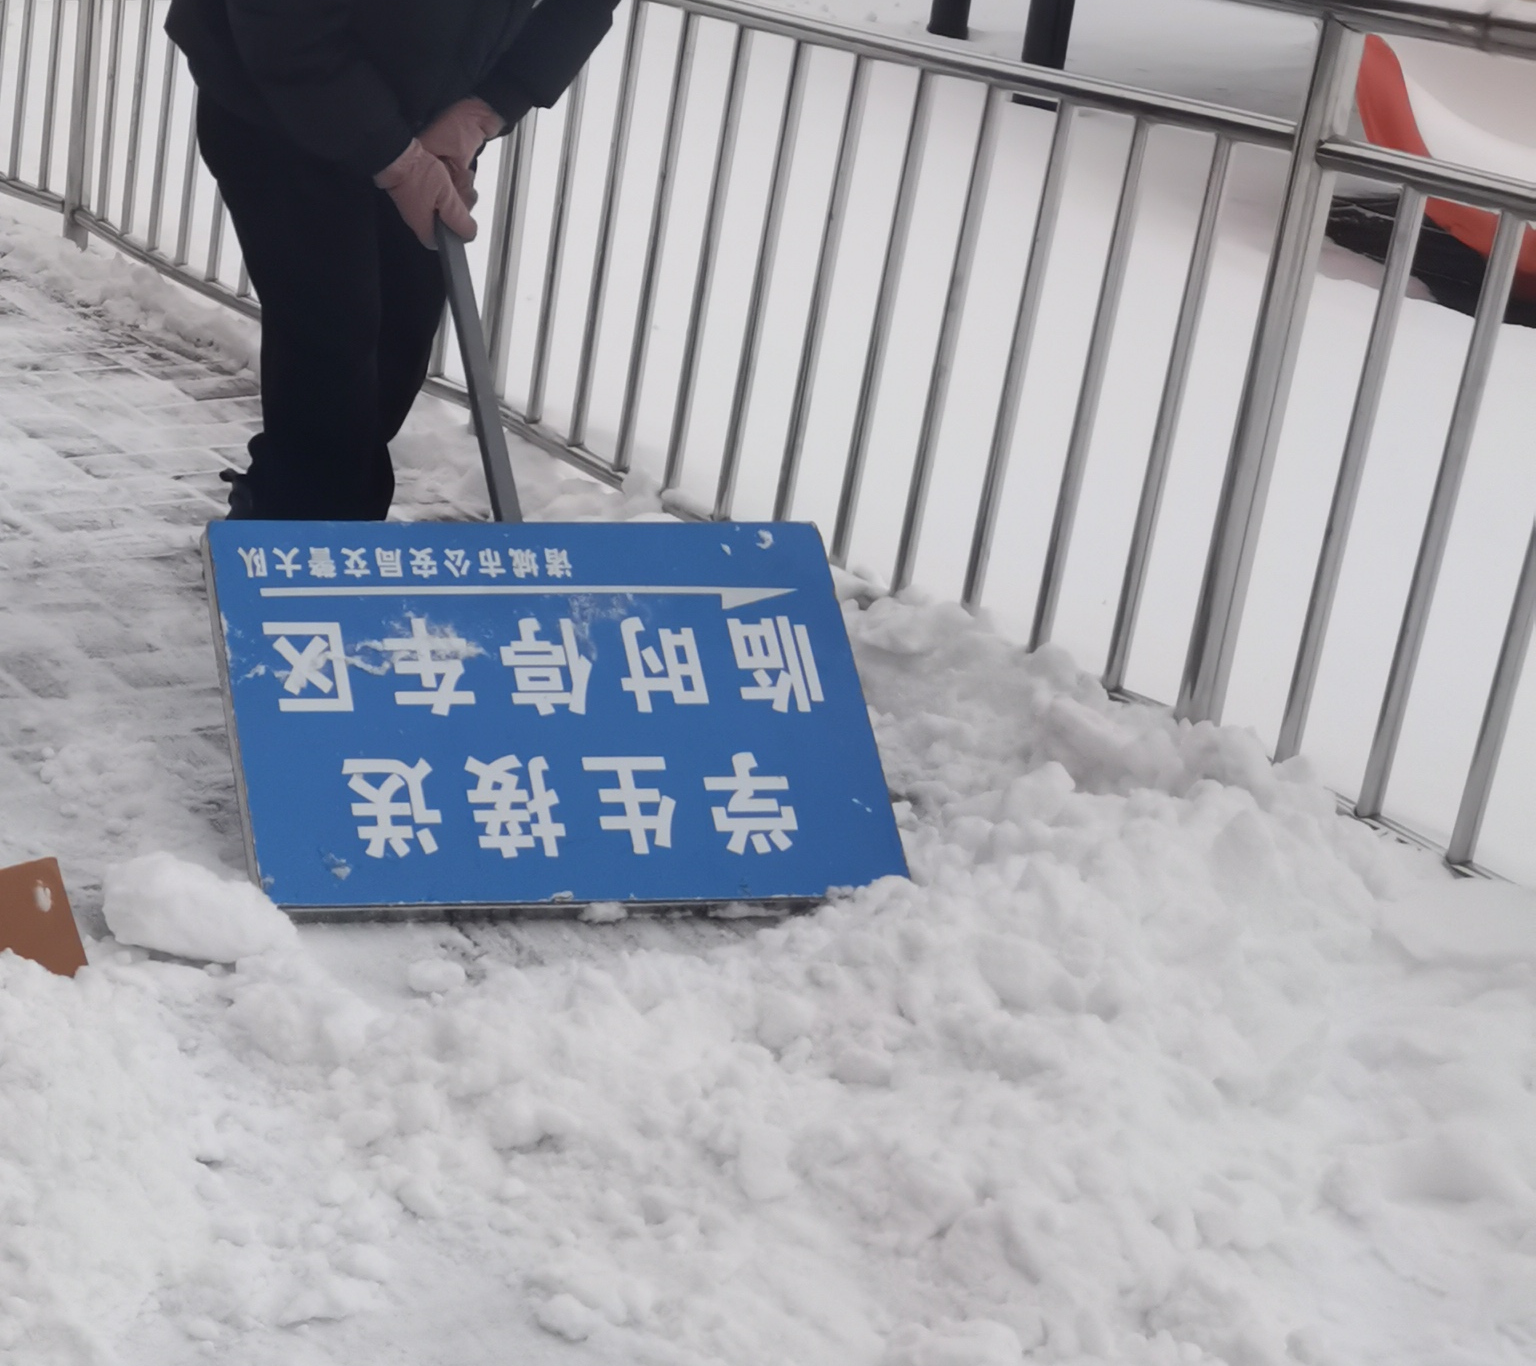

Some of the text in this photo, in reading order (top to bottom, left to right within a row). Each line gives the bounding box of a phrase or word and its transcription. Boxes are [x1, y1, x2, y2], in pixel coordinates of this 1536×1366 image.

[238, 546, 573, 579] 诸城市公安局交警大队
[262, 616, 825, 716] 临时停车区
[342, 752, 799, 860] 学生接送
